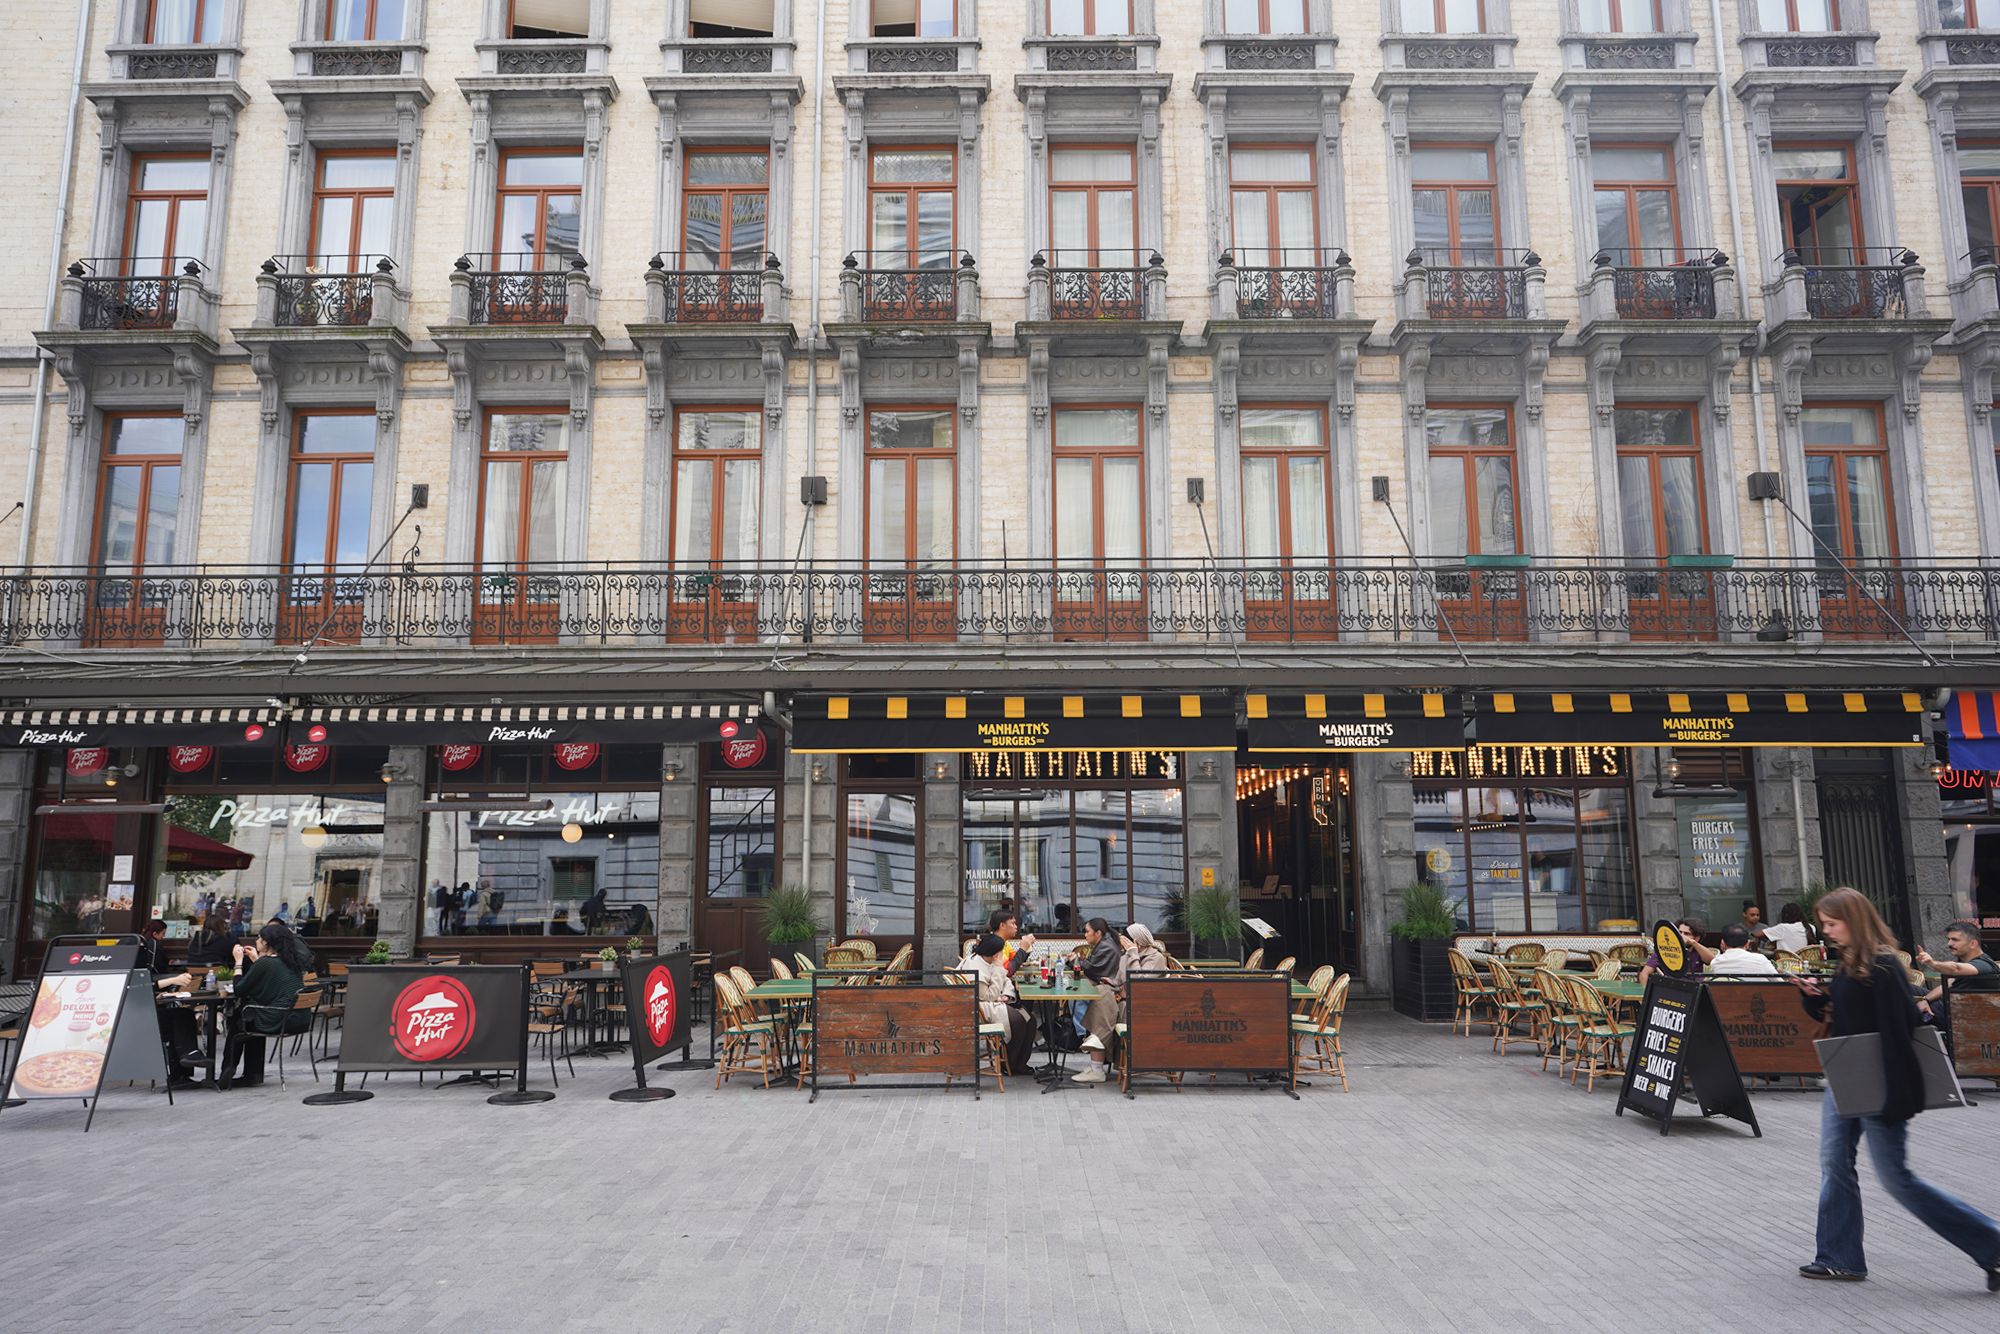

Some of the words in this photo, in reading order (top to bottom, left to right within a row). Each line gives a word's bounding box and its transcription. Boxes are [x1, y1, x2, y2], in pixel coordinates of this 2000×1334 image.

[978, 722, 1050, 736] MANHATTN'S
[1319, 722, 1394, 737] MANHATTN'S
[1663, 716, 1735, 730] MANHATTN'S
[19, 729, 58, 745] Pizza
[58, 729, 88, 744] Hut
[488, 726, 527, 742] Pizza
[526, 726, 557, 740] Hut
[1677, 731, 1722, 741] BURGERS
[992, 736, 1037, 747] BURGERS
[1334, 736, 1381, 747] BURGERS
[176, 746, 202, 759] Pizza
[444, 744, 471, 757] Pizza
[561, 744, 589, 757] Pizza
[729, 742, 756, 755] Pizza
[71, 750, 98, 763] Pizza
[180, 753, 202, 765] Hut
[296, 753, 318, 765] Hut
[449, 751, 470, 763] Hut
[566, 751, 588, 763] Hut
[734, 750, 755, 761] Hut
[1412, 746, 1619, 776] MANHATTN'S
[75, 758, 97, 770] Hut
[209, 800, 289, 829] Pizza
[289, 800, 352, 827] Hut
[561, 798, 620, 825] Hut
[1691, 821, 1735, 835] BURGERS
[1692, 837, 1720, 850] FRIES
[1702, 852, 1739, 865] SHAKES
[965, 868, 1012, 880] MANHATTN'S
[1693, 868, 1712, 878] BEER
[1721, 868, 1741, 878] WINE
[971, 880, 989, 889] STATE
[81, 954, 98, 962] Pizza
[98, 954, 112, 962] Hut
[63, 1003, 96, 1011] DELUXE
[650, 998, 669, 1025] Pizza
[406, 1009, 456, 1034] Pizza
[655, 1009, 669, 1034] Hut
[1171, 1019, 1248, 1032] MANHATTN'S
[1650, 1006, 1687, 1033] BURGERS
[414, 1024, 454, 1047] Hut
[1722, 1023, 1799, 1036] MANHATTN'S
[1186, 1033, 1233, 1044] BURGERS
[1644, 1029, 1668, 1053] FRIES
[1738, 1037, 1786, 1048] BURGERS
[844, 1039, 942, 1057] MANHATTN'S
[1645, 1054, 1677, 1081] SHAKES
[1633, 1074, 1650, 1092] BEER
[1654, 1081, 1672, 1101] WINE
